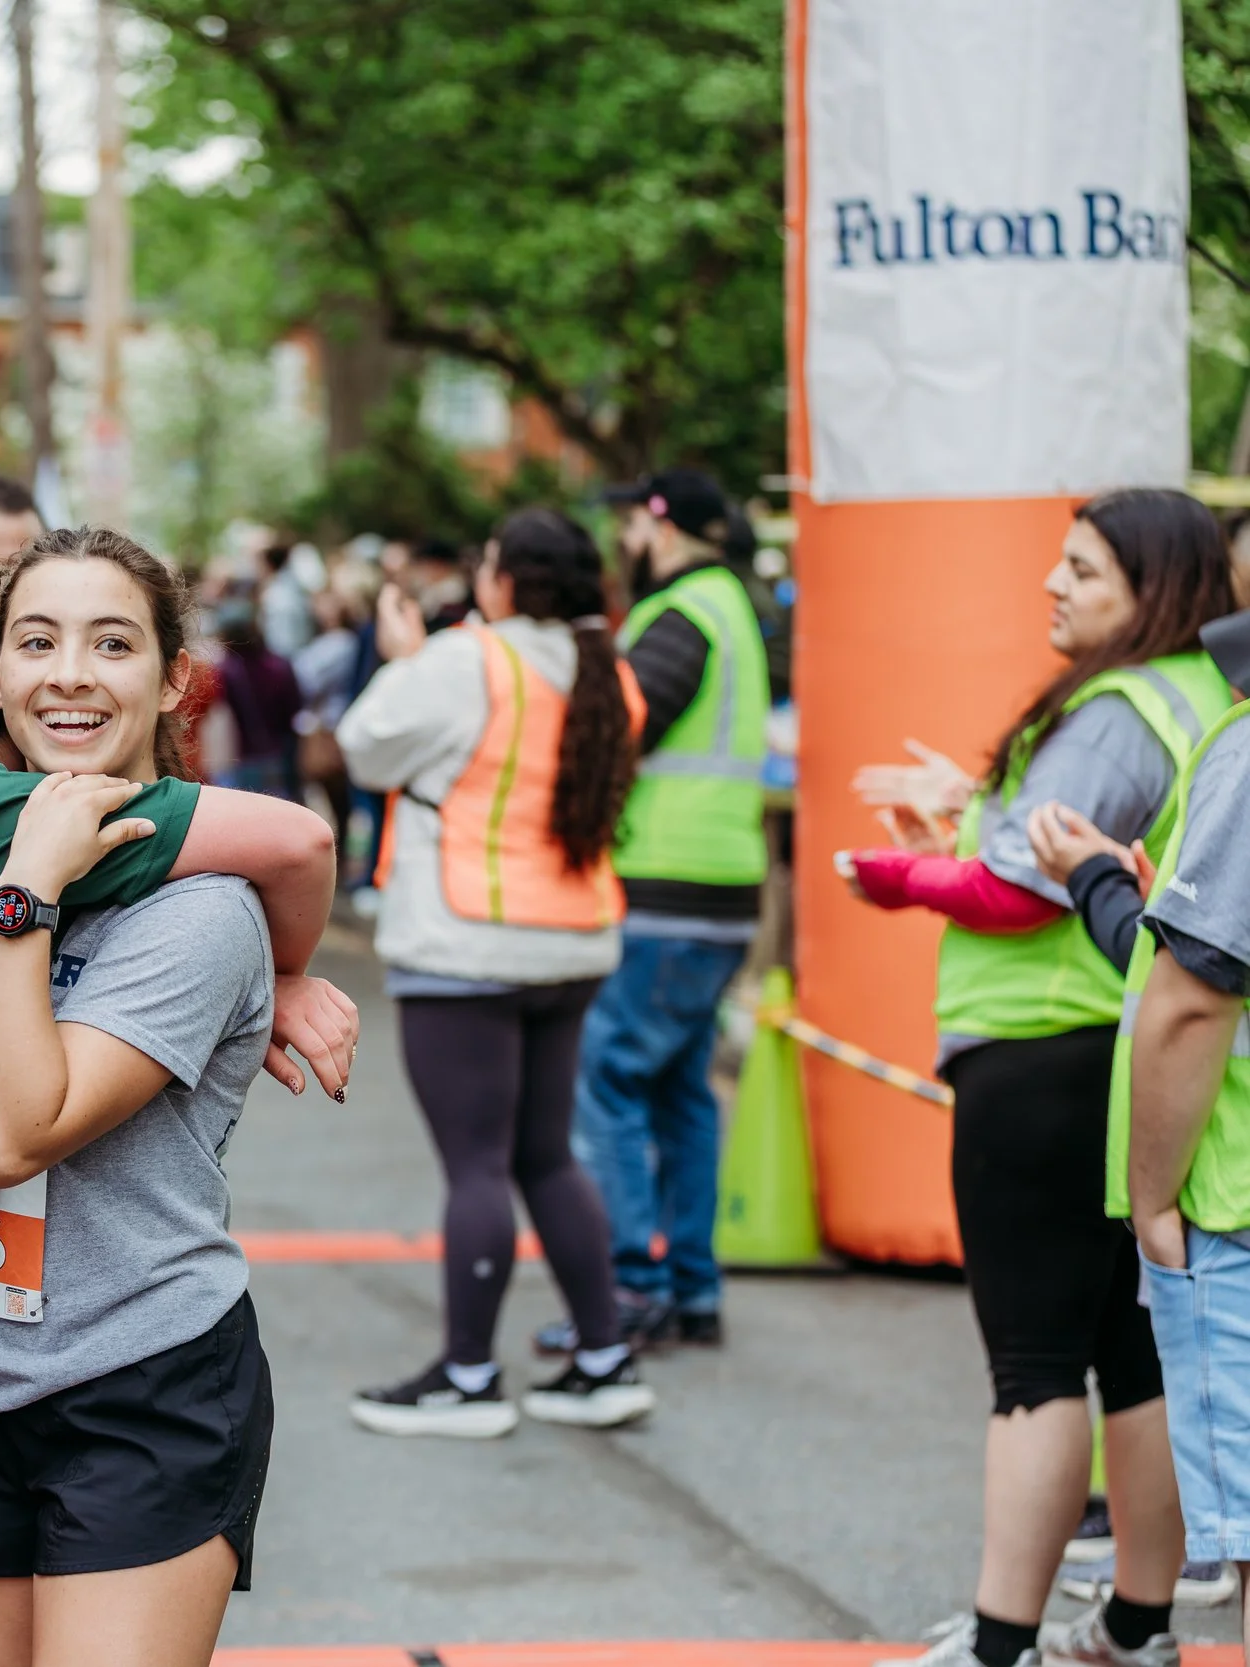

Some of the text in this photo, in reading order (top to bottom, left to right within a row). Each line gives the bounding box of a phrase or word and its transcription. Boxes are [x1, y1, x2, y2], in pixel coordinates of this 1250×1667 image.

[834, 187, 1184, 268] Fulton Ban
[15, 903, 24, 918] 183
